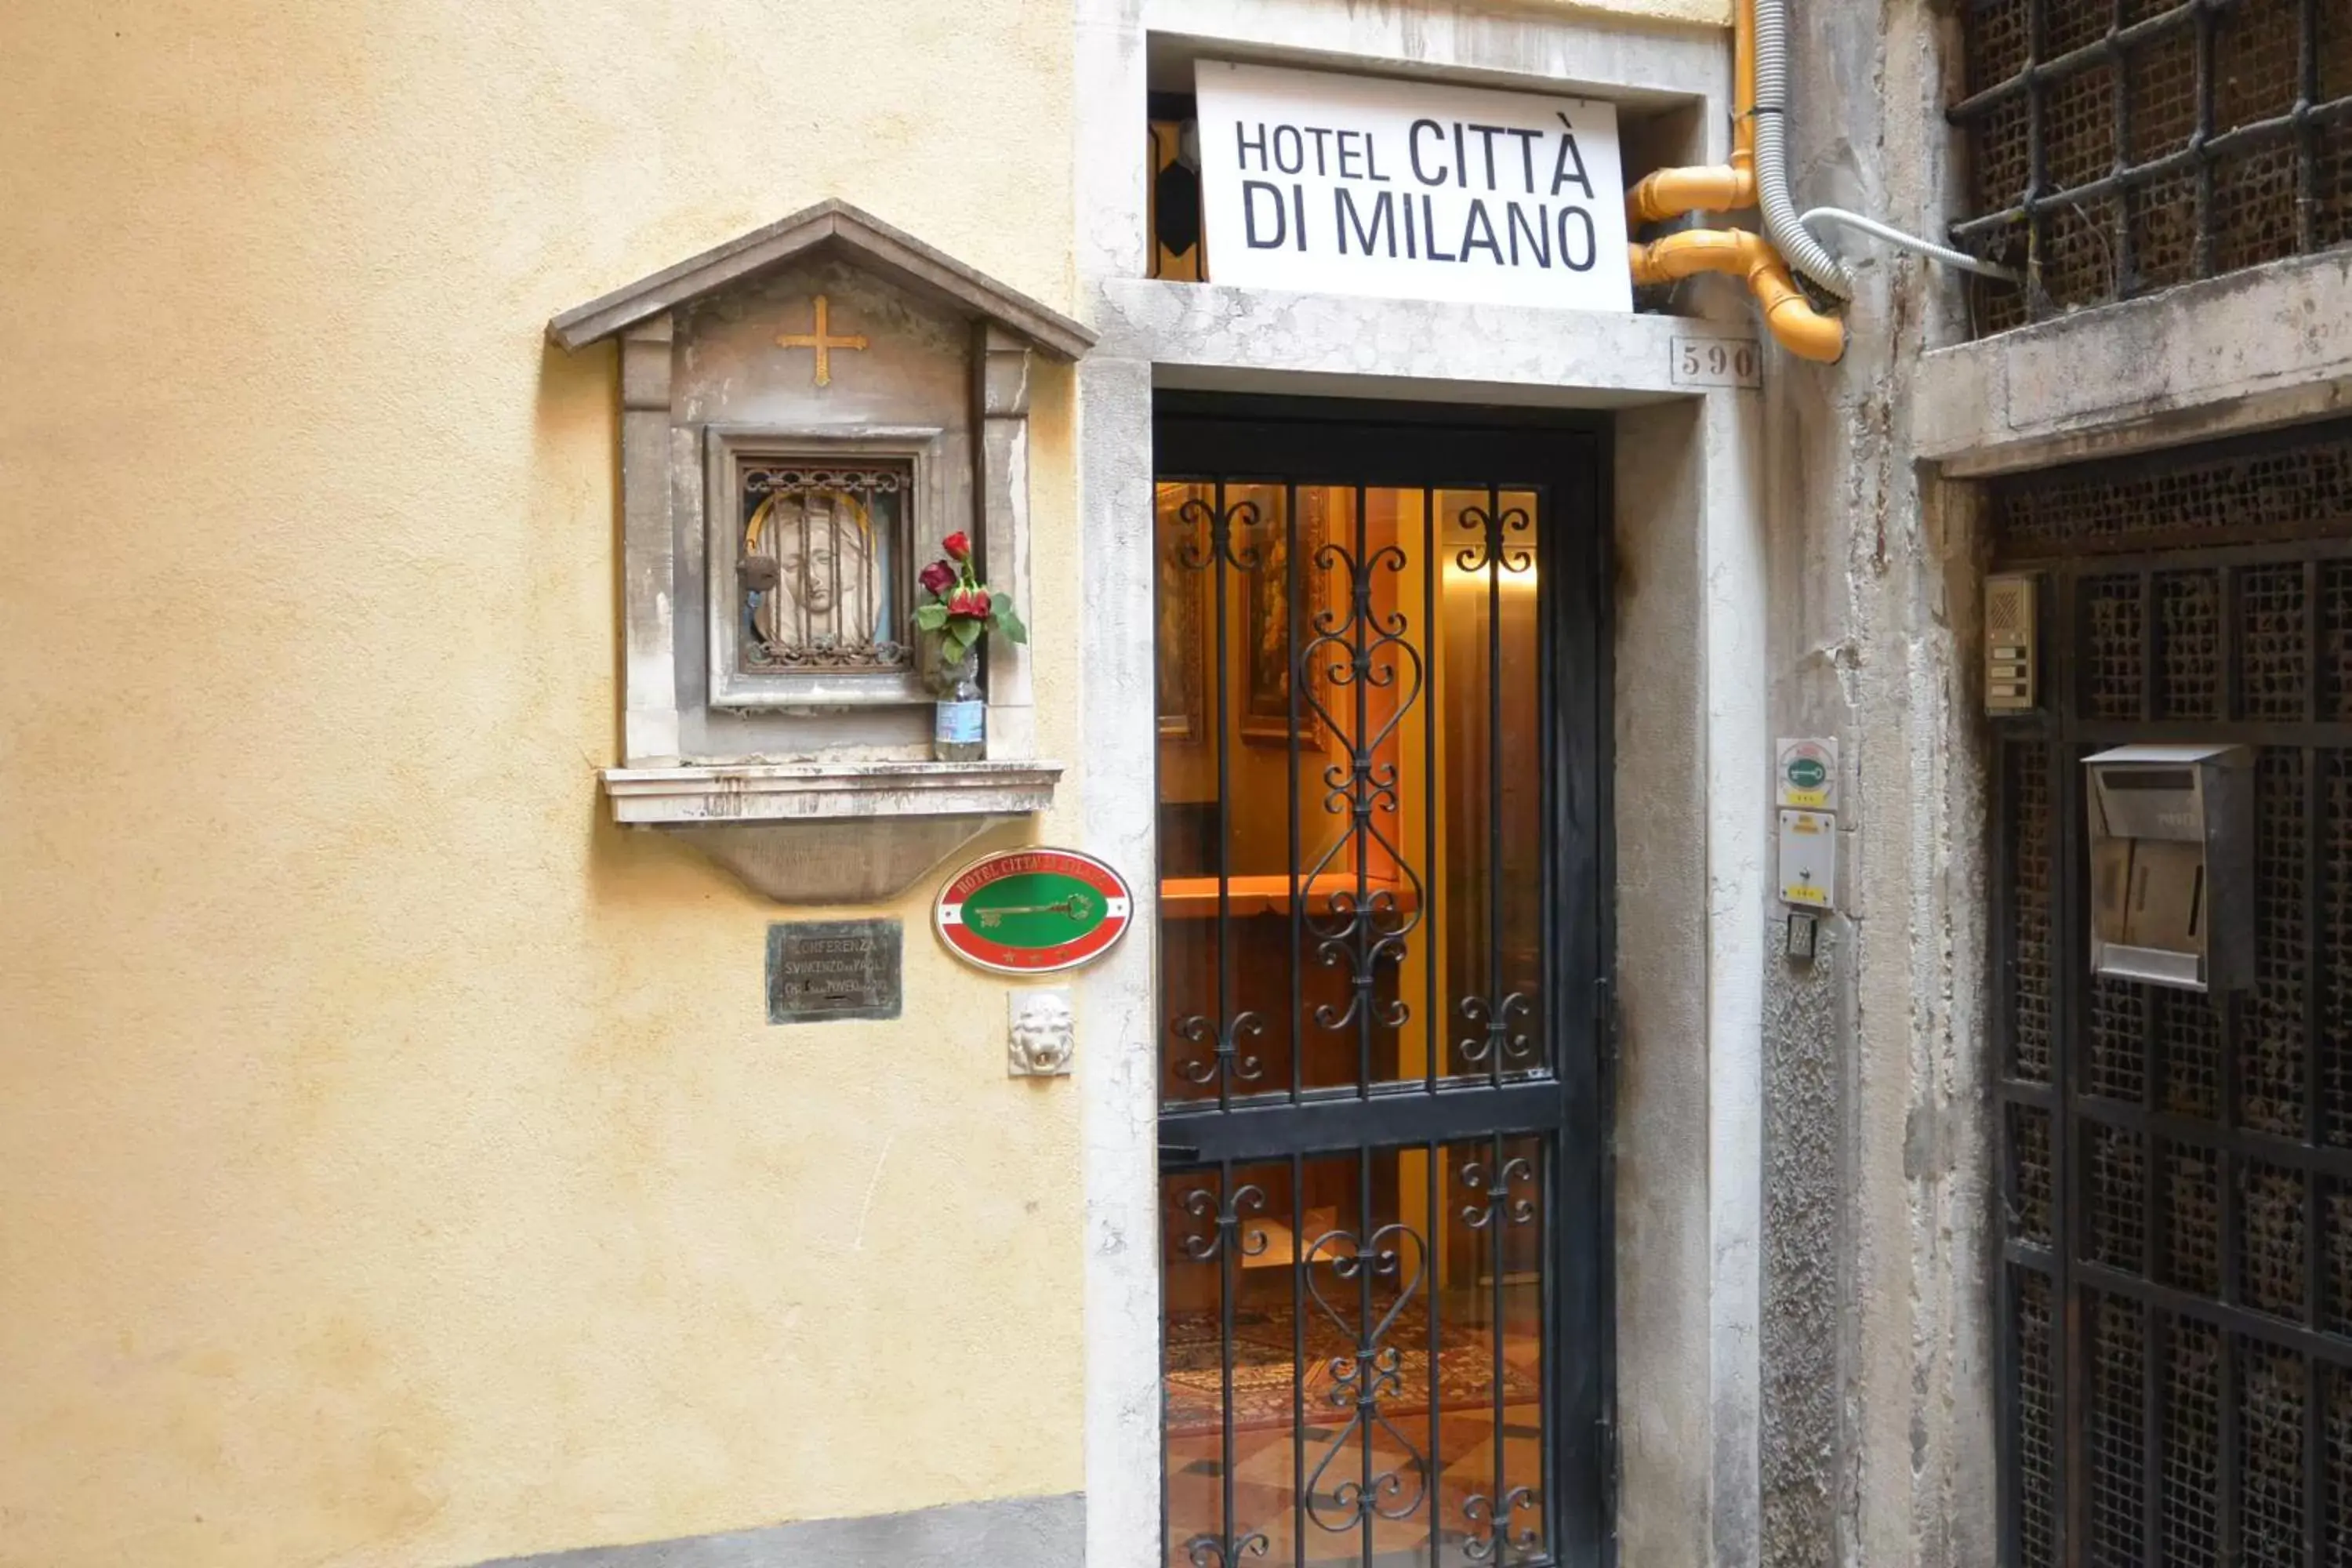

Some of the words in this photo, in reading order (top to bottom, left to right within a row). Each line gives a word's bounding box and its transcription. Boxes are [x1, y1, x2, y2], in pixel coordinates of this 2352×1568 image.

[1236, 120, 1391, 182] HOTEL
[1408, 111, 1595, 200] CITTÀ
[1242, 180, 1307, 252] DI
[1334, 187, 1596, 272] MILANO
[1682, 346, 1753, 377] 590
[956, 863, 1000, 895] HOTEL
